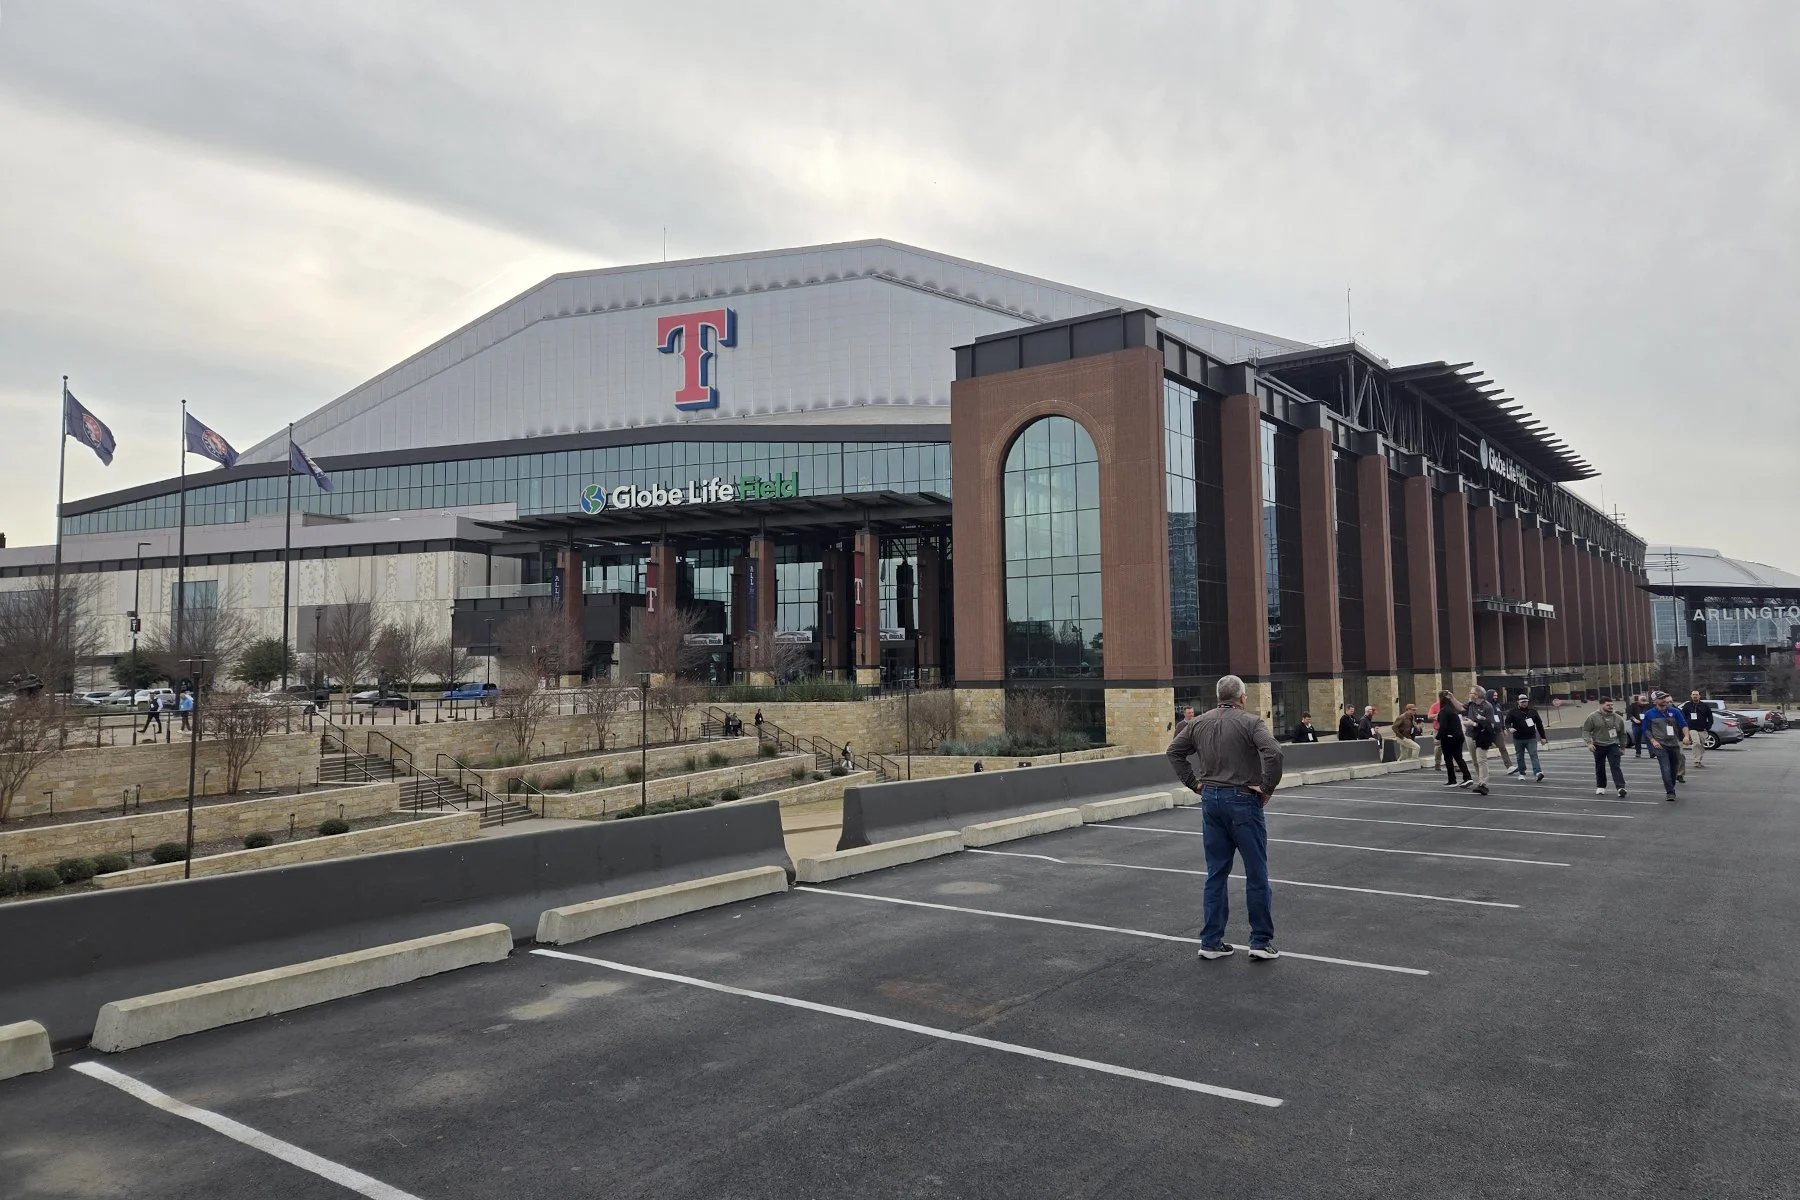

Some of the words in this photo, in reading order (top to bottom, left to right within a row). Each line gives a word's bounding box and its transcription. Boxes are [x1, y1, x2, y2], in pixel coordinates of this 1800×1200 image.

[657, 306, 737, 411] T
[1489, 447, 1506, 477] Globe
[611, 484, 683, 509] Globe
[688, 477, 734, 504] Life
[739, 472, 798, 500] Field
[1693, 606, 1800, 621] ARLINGTO
